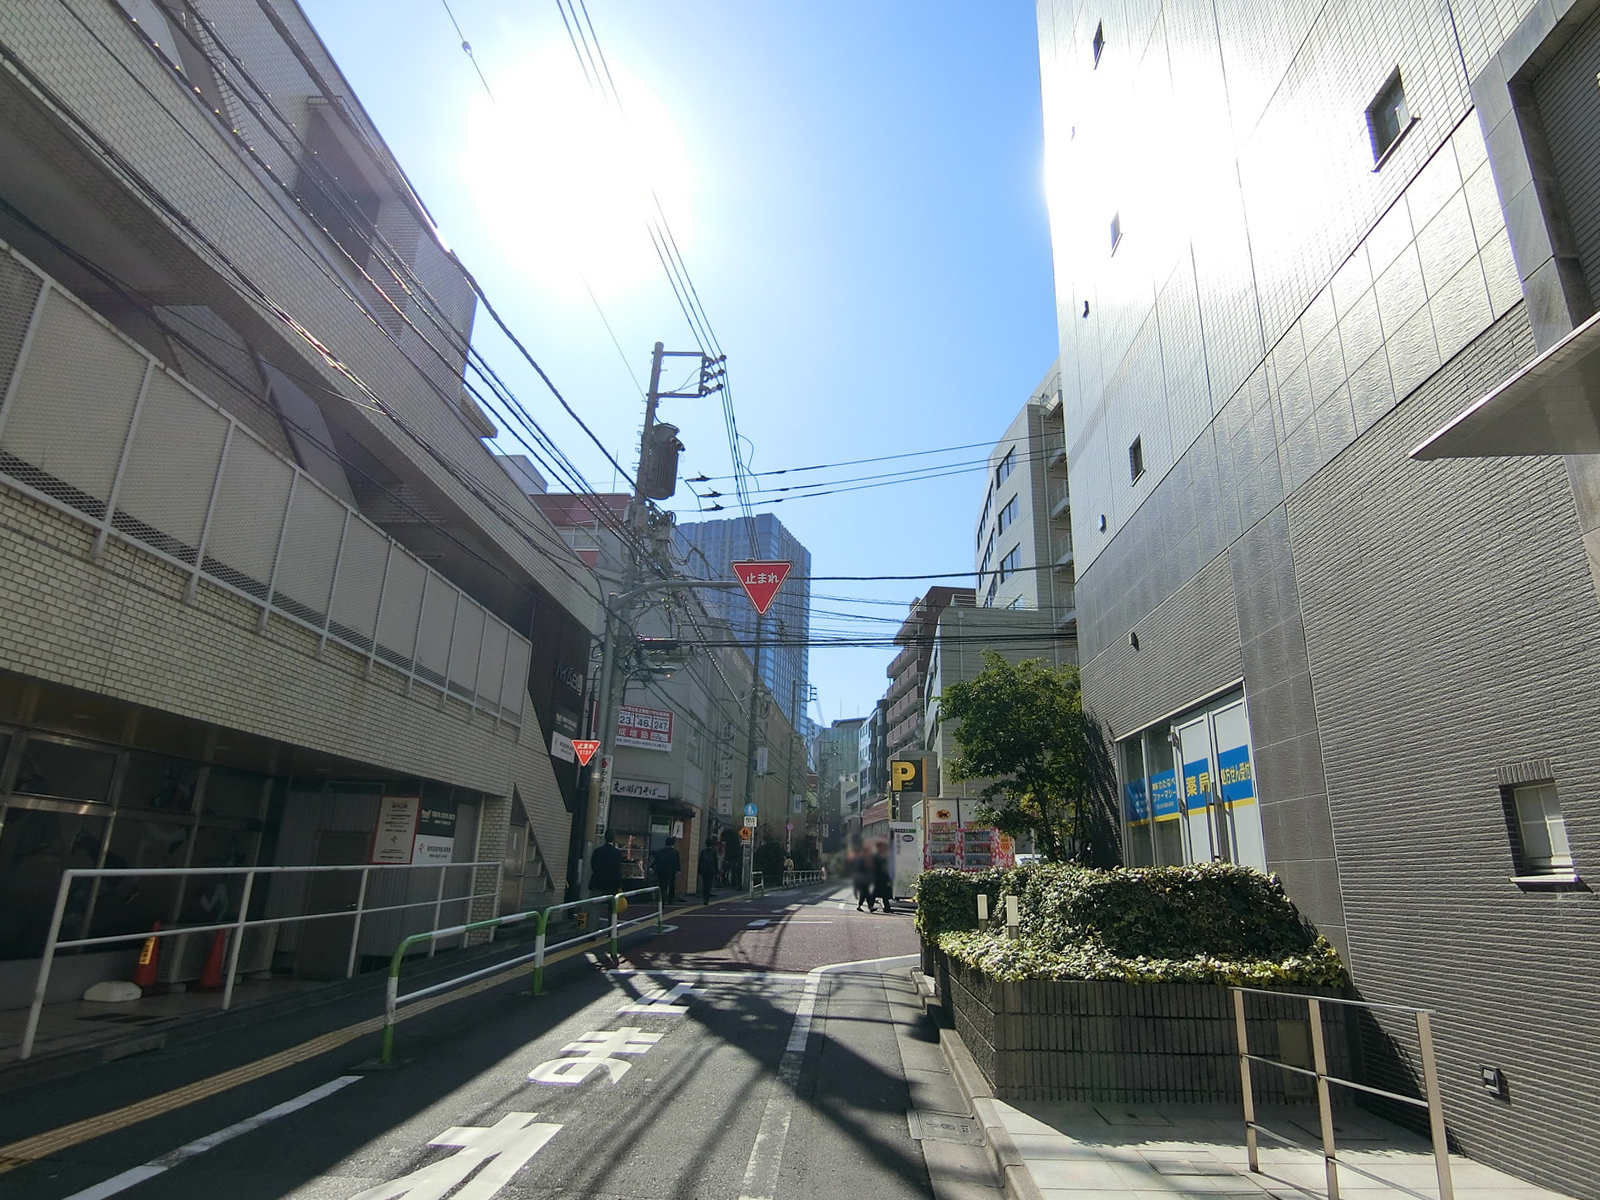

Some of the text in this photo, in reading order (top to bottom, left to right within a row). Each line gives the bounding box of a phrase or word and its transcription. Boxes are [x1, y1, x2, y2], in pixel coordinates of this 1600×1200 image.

[745, 572, 779, 584] 止まれ
[892, 761, 916, 791] P
[1185, 772, 1212, 797] 薬局
[1220, 761, 1251, 786] 処方せん受付
[1152, 789, 1177, 802] ファーマシー
[347, 982, 708, 1200] 止まれ
